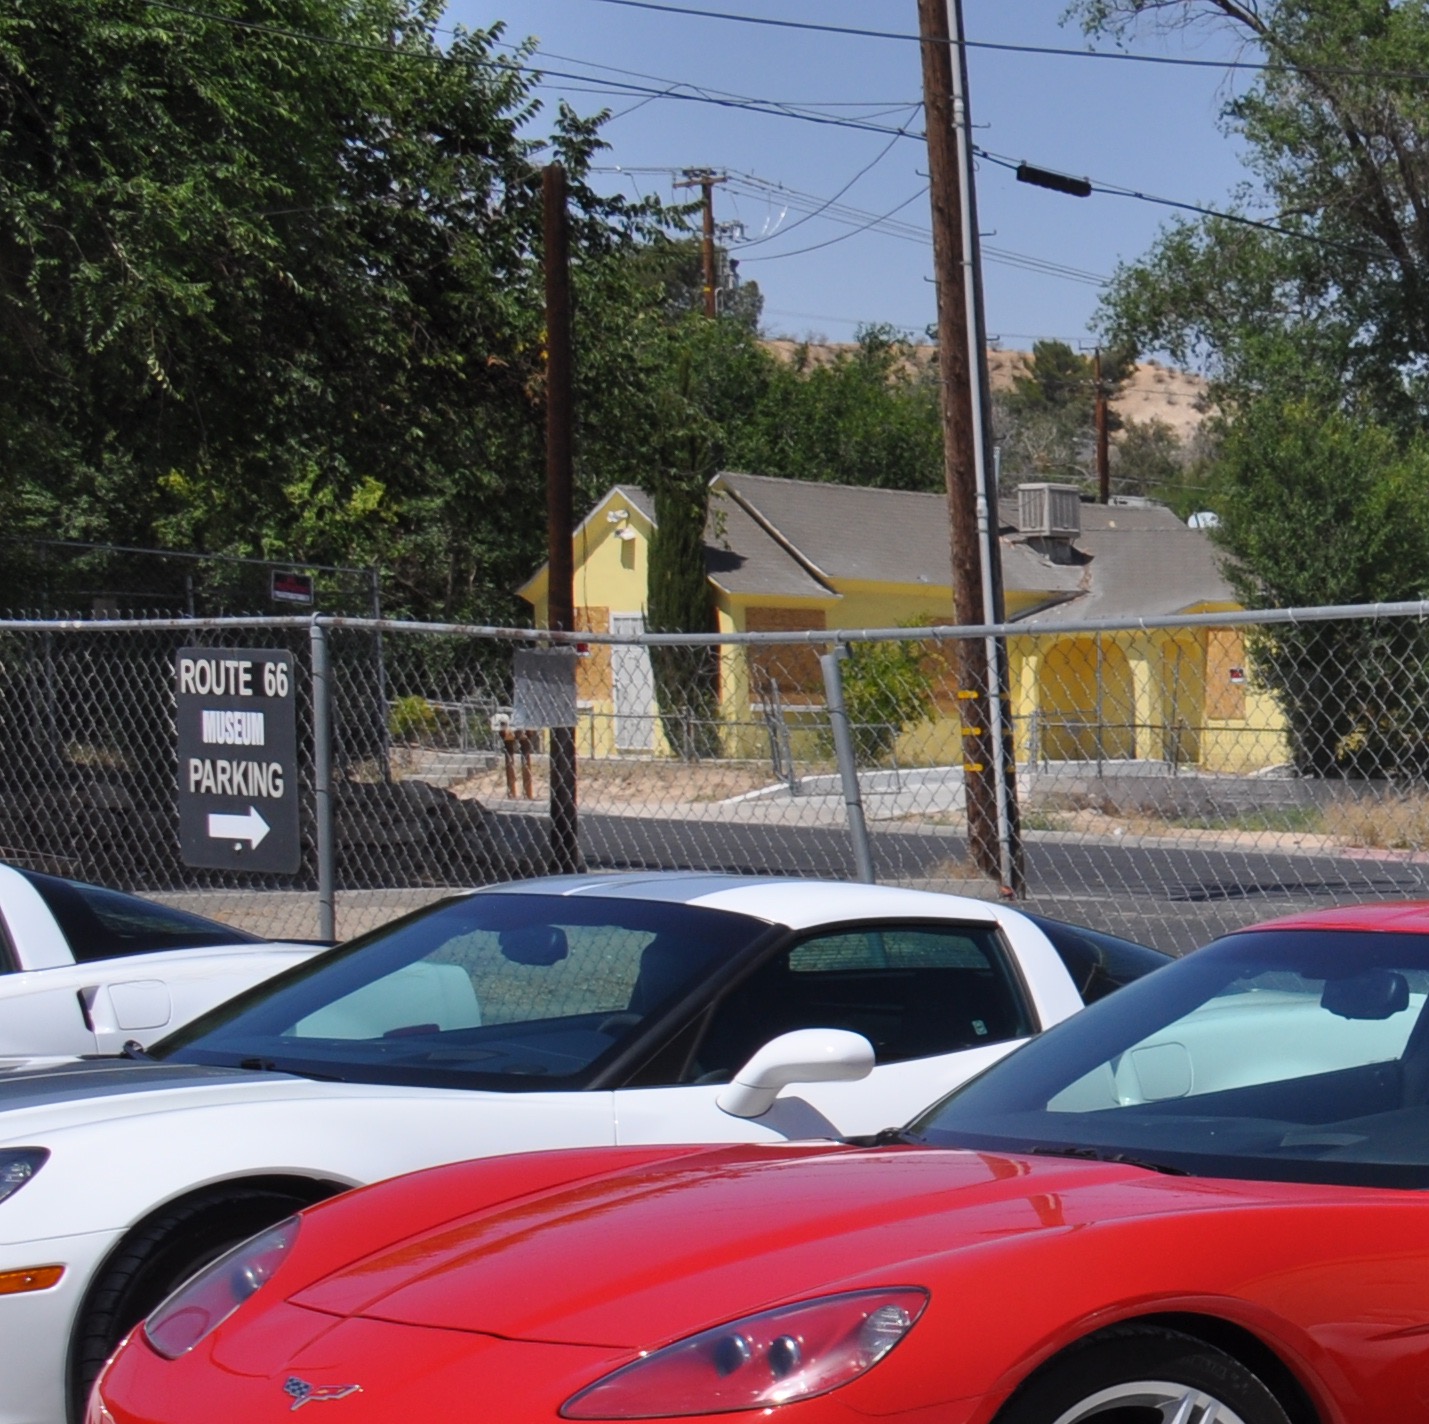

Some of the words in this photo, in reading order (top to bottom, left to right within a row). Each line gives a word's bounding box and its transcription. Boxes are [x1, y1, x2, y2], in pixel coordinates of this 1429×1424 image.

[180, 658, 253, 696] ROUTE
[264, 661, 289, 697] 66
[202, 709, 265, 746] MUSEUM
[189, 758, 285, 798] PARKING
